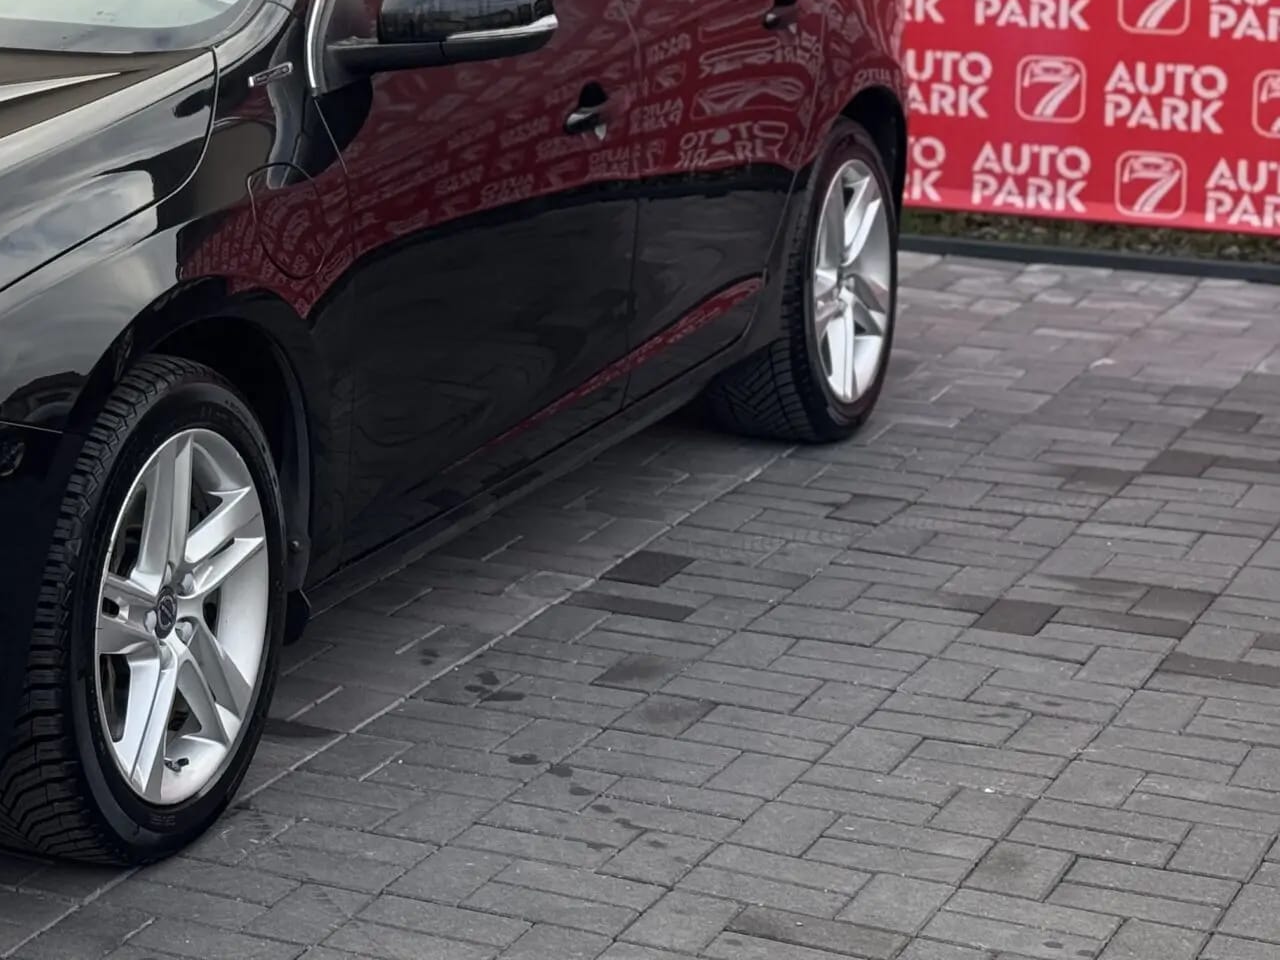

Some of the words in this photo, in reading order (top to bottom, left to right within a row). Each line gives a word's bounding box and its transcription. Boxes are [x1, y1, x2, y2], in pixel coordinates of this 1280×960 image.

[906, 48, 993, 85] UTO
[1105, 62, 1227, 99] AUTO
[1105, 94, 1222, 133] PARK
[973, 143, 1090, 179] AUTO
[971, 174, 1086, 213] PARK
